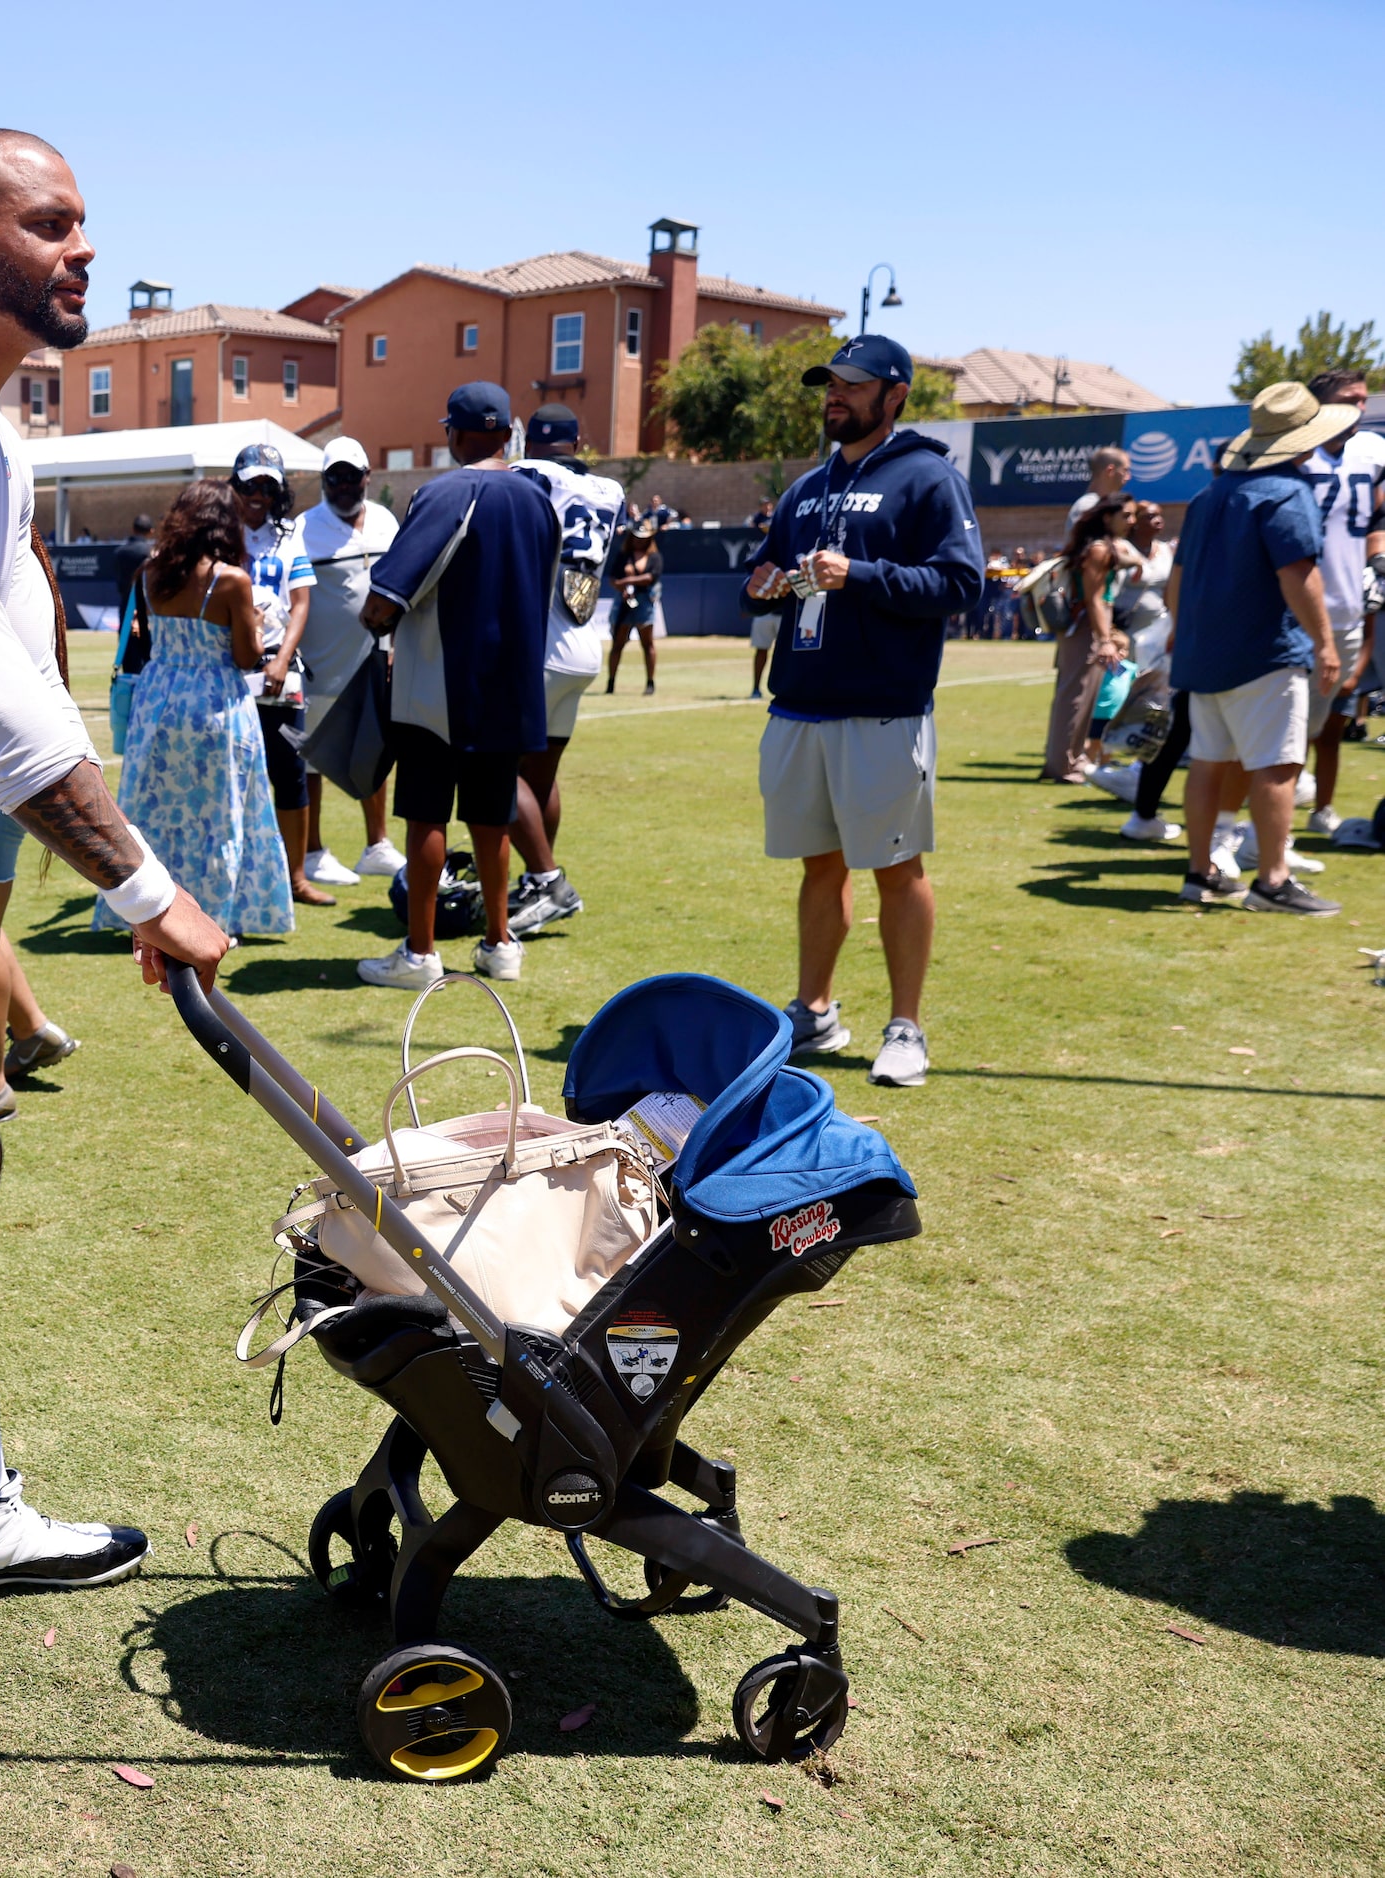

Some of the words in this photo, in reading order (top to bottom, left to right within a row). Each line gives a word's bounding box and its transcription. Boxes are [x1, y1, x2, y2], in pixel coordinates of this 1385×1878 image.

[1057, 471, 1093, 482] MANU
[633, 1112, 664, 1147] ADVERTENCIA
[771, 1203, 831, 1249] Kissing
[793, 1221, 838, 1254] Cowboys
[433, 1267, 457, 1295] WARNING
